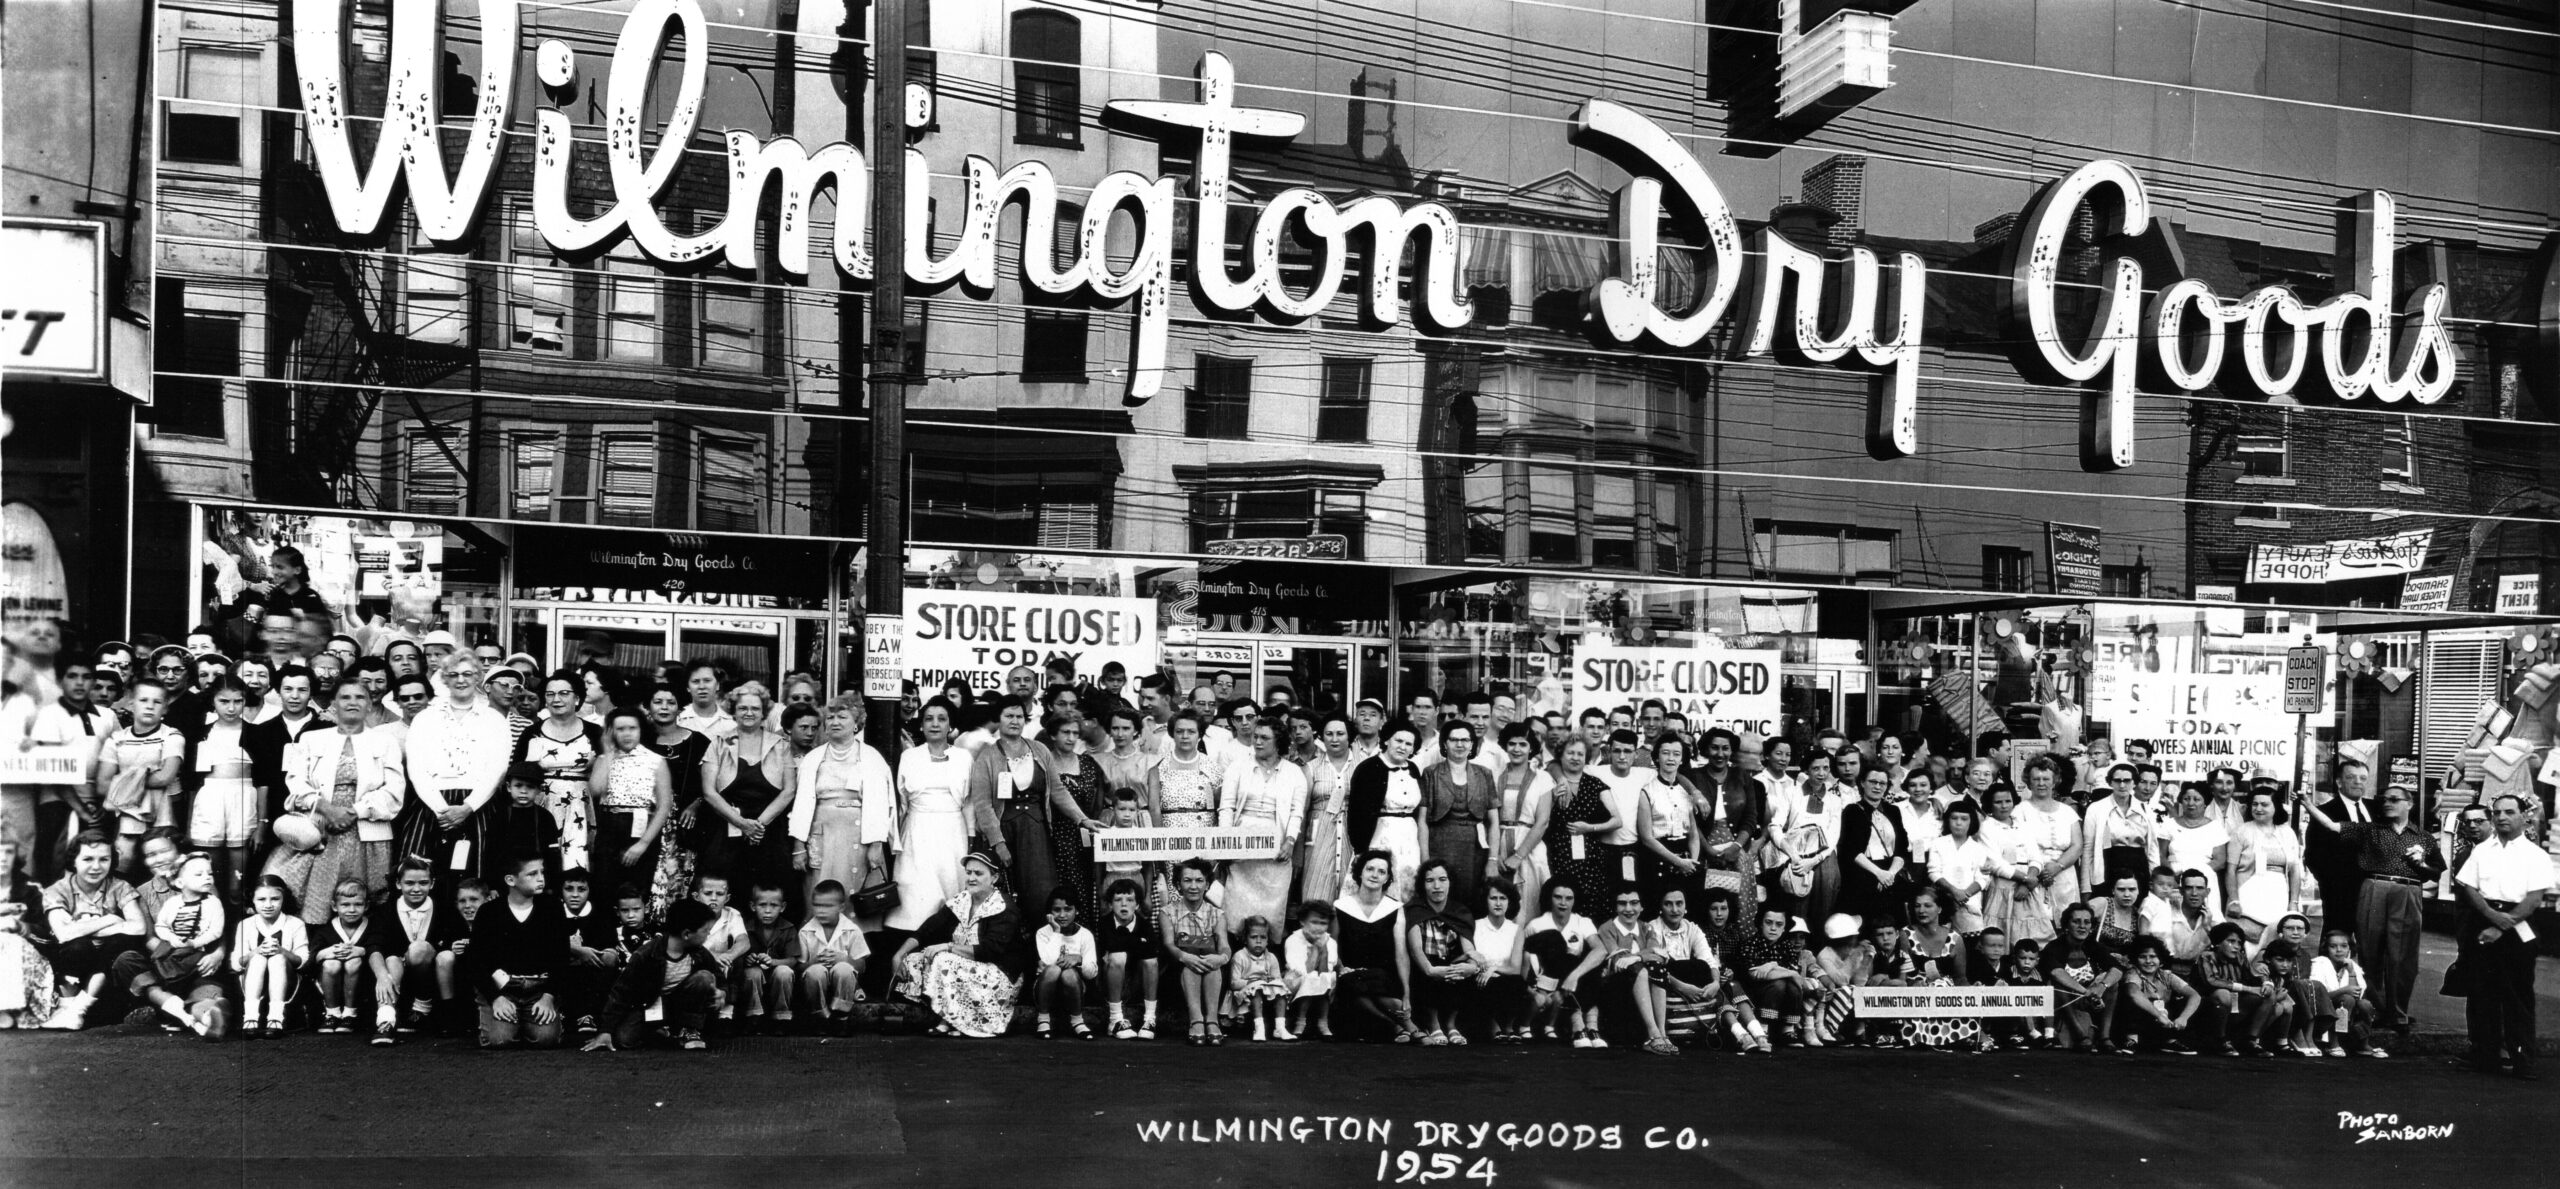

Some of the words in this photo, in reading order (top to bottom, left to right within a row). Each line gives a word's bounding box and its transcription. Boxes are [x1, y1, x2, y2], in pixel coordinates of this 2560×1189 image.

[293, 0, 1475, 402] Wilmington
[1574, 97, 1926, 455] Dry
[2022, 159, 2457, 468] Goods
[590, 551, 657, 569] Wilmington
[662, 552, 688, 572] Dry
[695, 554, 735, 572] Goods
[662, 579, 685, 589] 420
[1199, 580, 1243, 597] lmington
[1249, 582, 1270, 599] Dry
[1275, 583, 1310, 599] Goods
[865, 624, 886, 634] OBEY
[916, 602, 1016, 642] STORE
[1025, 607, 1141, 647] CLOSED
[868, 638, 901, 653] LAW
[867, 657, 890, 665] CROSS
[972, 648, 1083, 666] TODAY
[2290, 657, 2317, 670] COACH
[1583, 658, 1665, 692] STORE
[1671, 660, 1770, 695] CLOSED
[2288, 677, 2315, 690] STOP
[872, 682, 895, 691] ONLY
[2287, 696, 2293, 705] NO
[2166, 719, 2241, 735] TODAY
[2124, 738, 2186, 754] EOYEES
[2190, 739, 2234, 754] ANNUAL
[2240, 740, 2287, 755] PICNIC
[2154, 760, 2186, 772] PEN
[1101, 838, 1149, 851] WILMINGTON
[1151, 837, 1167, 851] DRY
[1169, 836, 1192, 850] GOODS
[1195, 837, 1207, 850] CO.
[1210, 836, 1242, 849] ANNUAL
[1245, 836, 1275, 849] OUTING
[1864, 996, 1913, 1008] WILMINGTON
[1915, 996, 1931, 1008] DRY
[1935, 996, 1963, 1007] GOODS
[1965, 996, 1978, 1007] CO.
[1981, 995, 2013, 1007] ANNUAL
[2014, 995, 2044, 1007] OUTING
